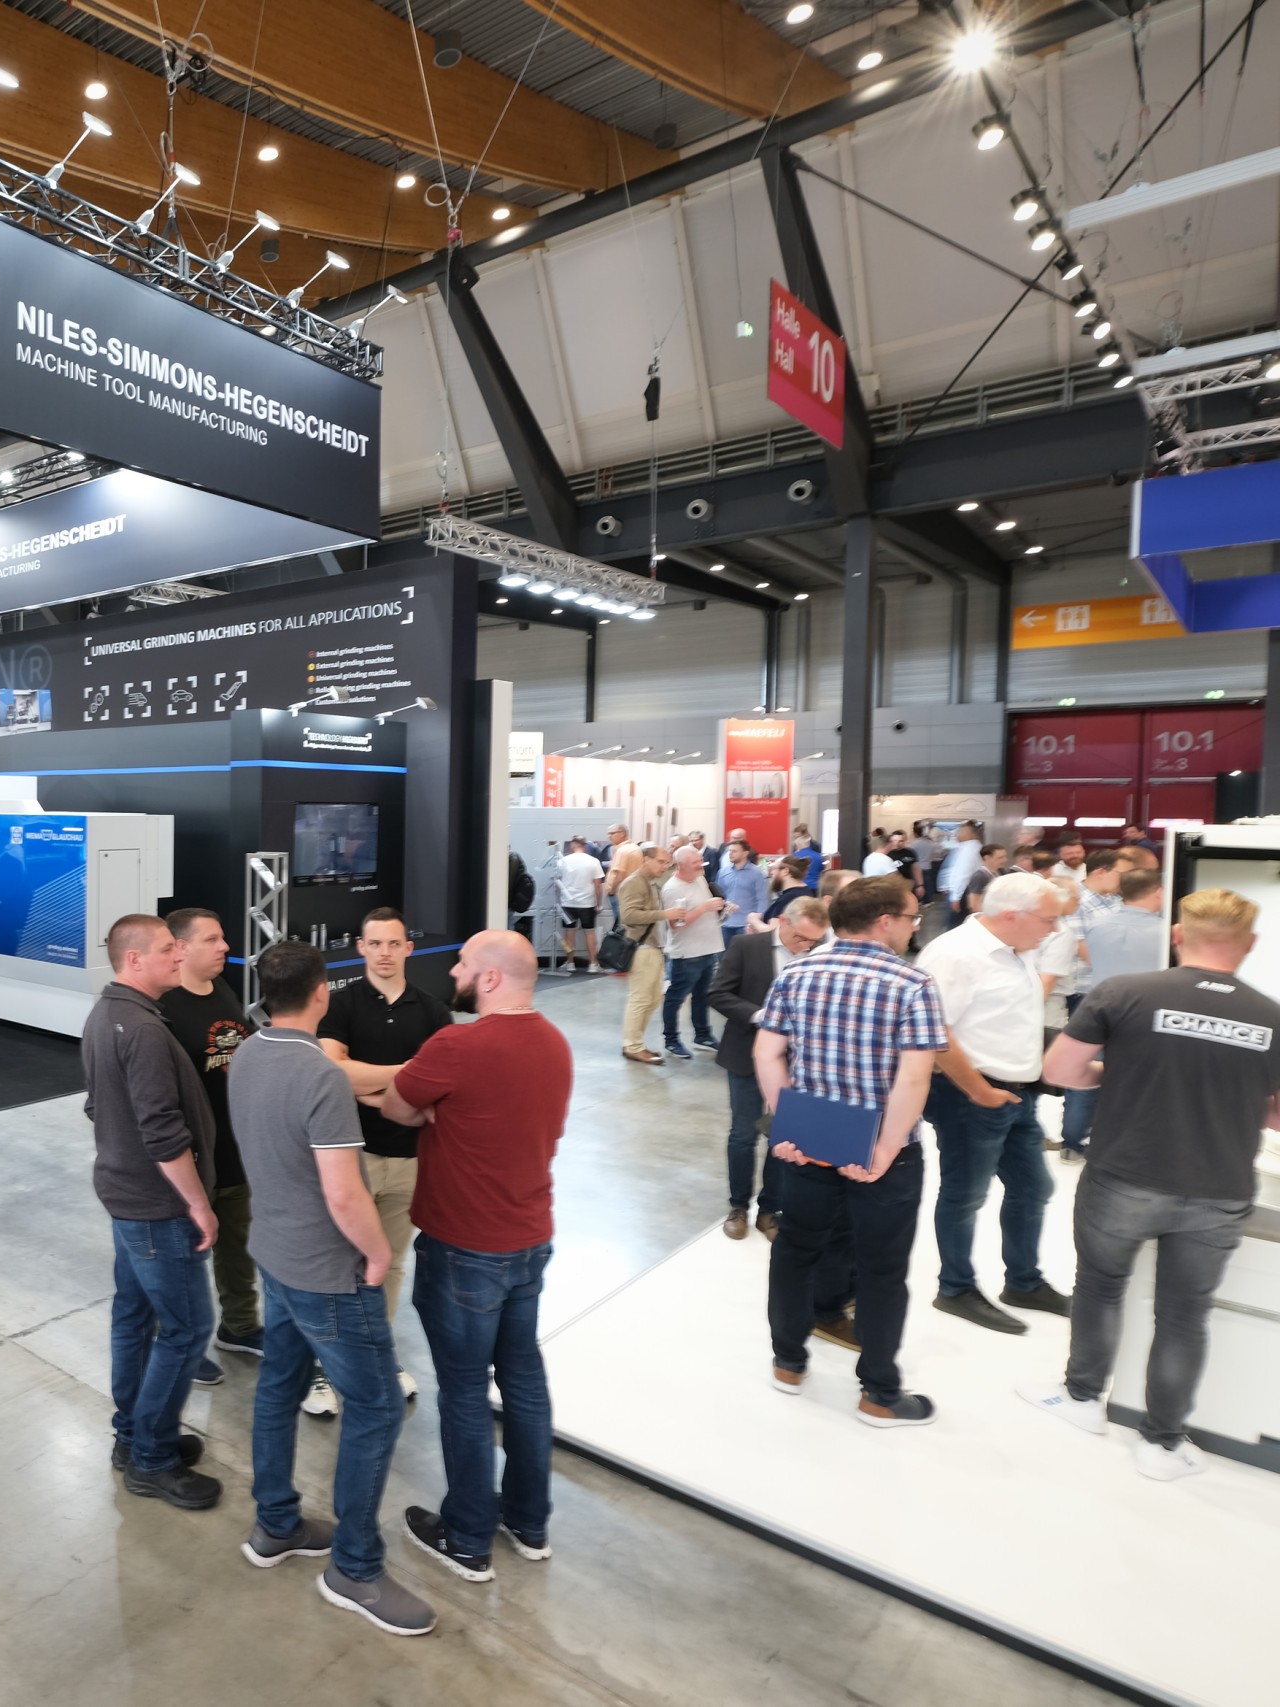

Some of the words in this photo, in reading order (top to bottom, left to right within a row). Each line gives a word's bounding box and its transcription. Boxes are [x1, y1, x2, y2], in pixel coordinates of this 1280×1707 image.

[776, 297, 801, 340] Halle
[775, 338, 794, 375] Hall
[808, 331, 835, 404] 10
[17, 301, 369, 457] NILES-SIMMONS-HEGENSCHEIDT
[16, 342, 98, 388] MACHINE
[102, 373, 145, 404] TOOL
[148, 390, 268, 446] MANUFACTURING
[90, 639, 142, 657] UNIVERSAL
[143, 631, 195, 649] GRINDING
[196, 622, 257, 642] MACHINES
[258, 618, 282, 634] FOR
[284, 615, 306, 630] ALL
[308, 600, 402, 627] APPLICATIONS
[339, 646, 364, 656] grinding
[364, 643, 394, 652] machines
[340, 659, 365, 668] grinding
[365, 656, 394, 665] machines
[342, 670, 368, 680] grinding
[368, 668, 397, 677] machines
[355, 682, 381, 692] grinding
[381, 679, 411, 688] machines
[1023, 734, 1076, 755] 10.1
[1154, 730, 1214, 753] 10.1
[1043, 760, 1053, 773] 3
[1177, 757, 1188, 771] 3
[1163, 1014, 1265, 1044] CHANCE
[204, 1054, 233, 1072] MOTO
